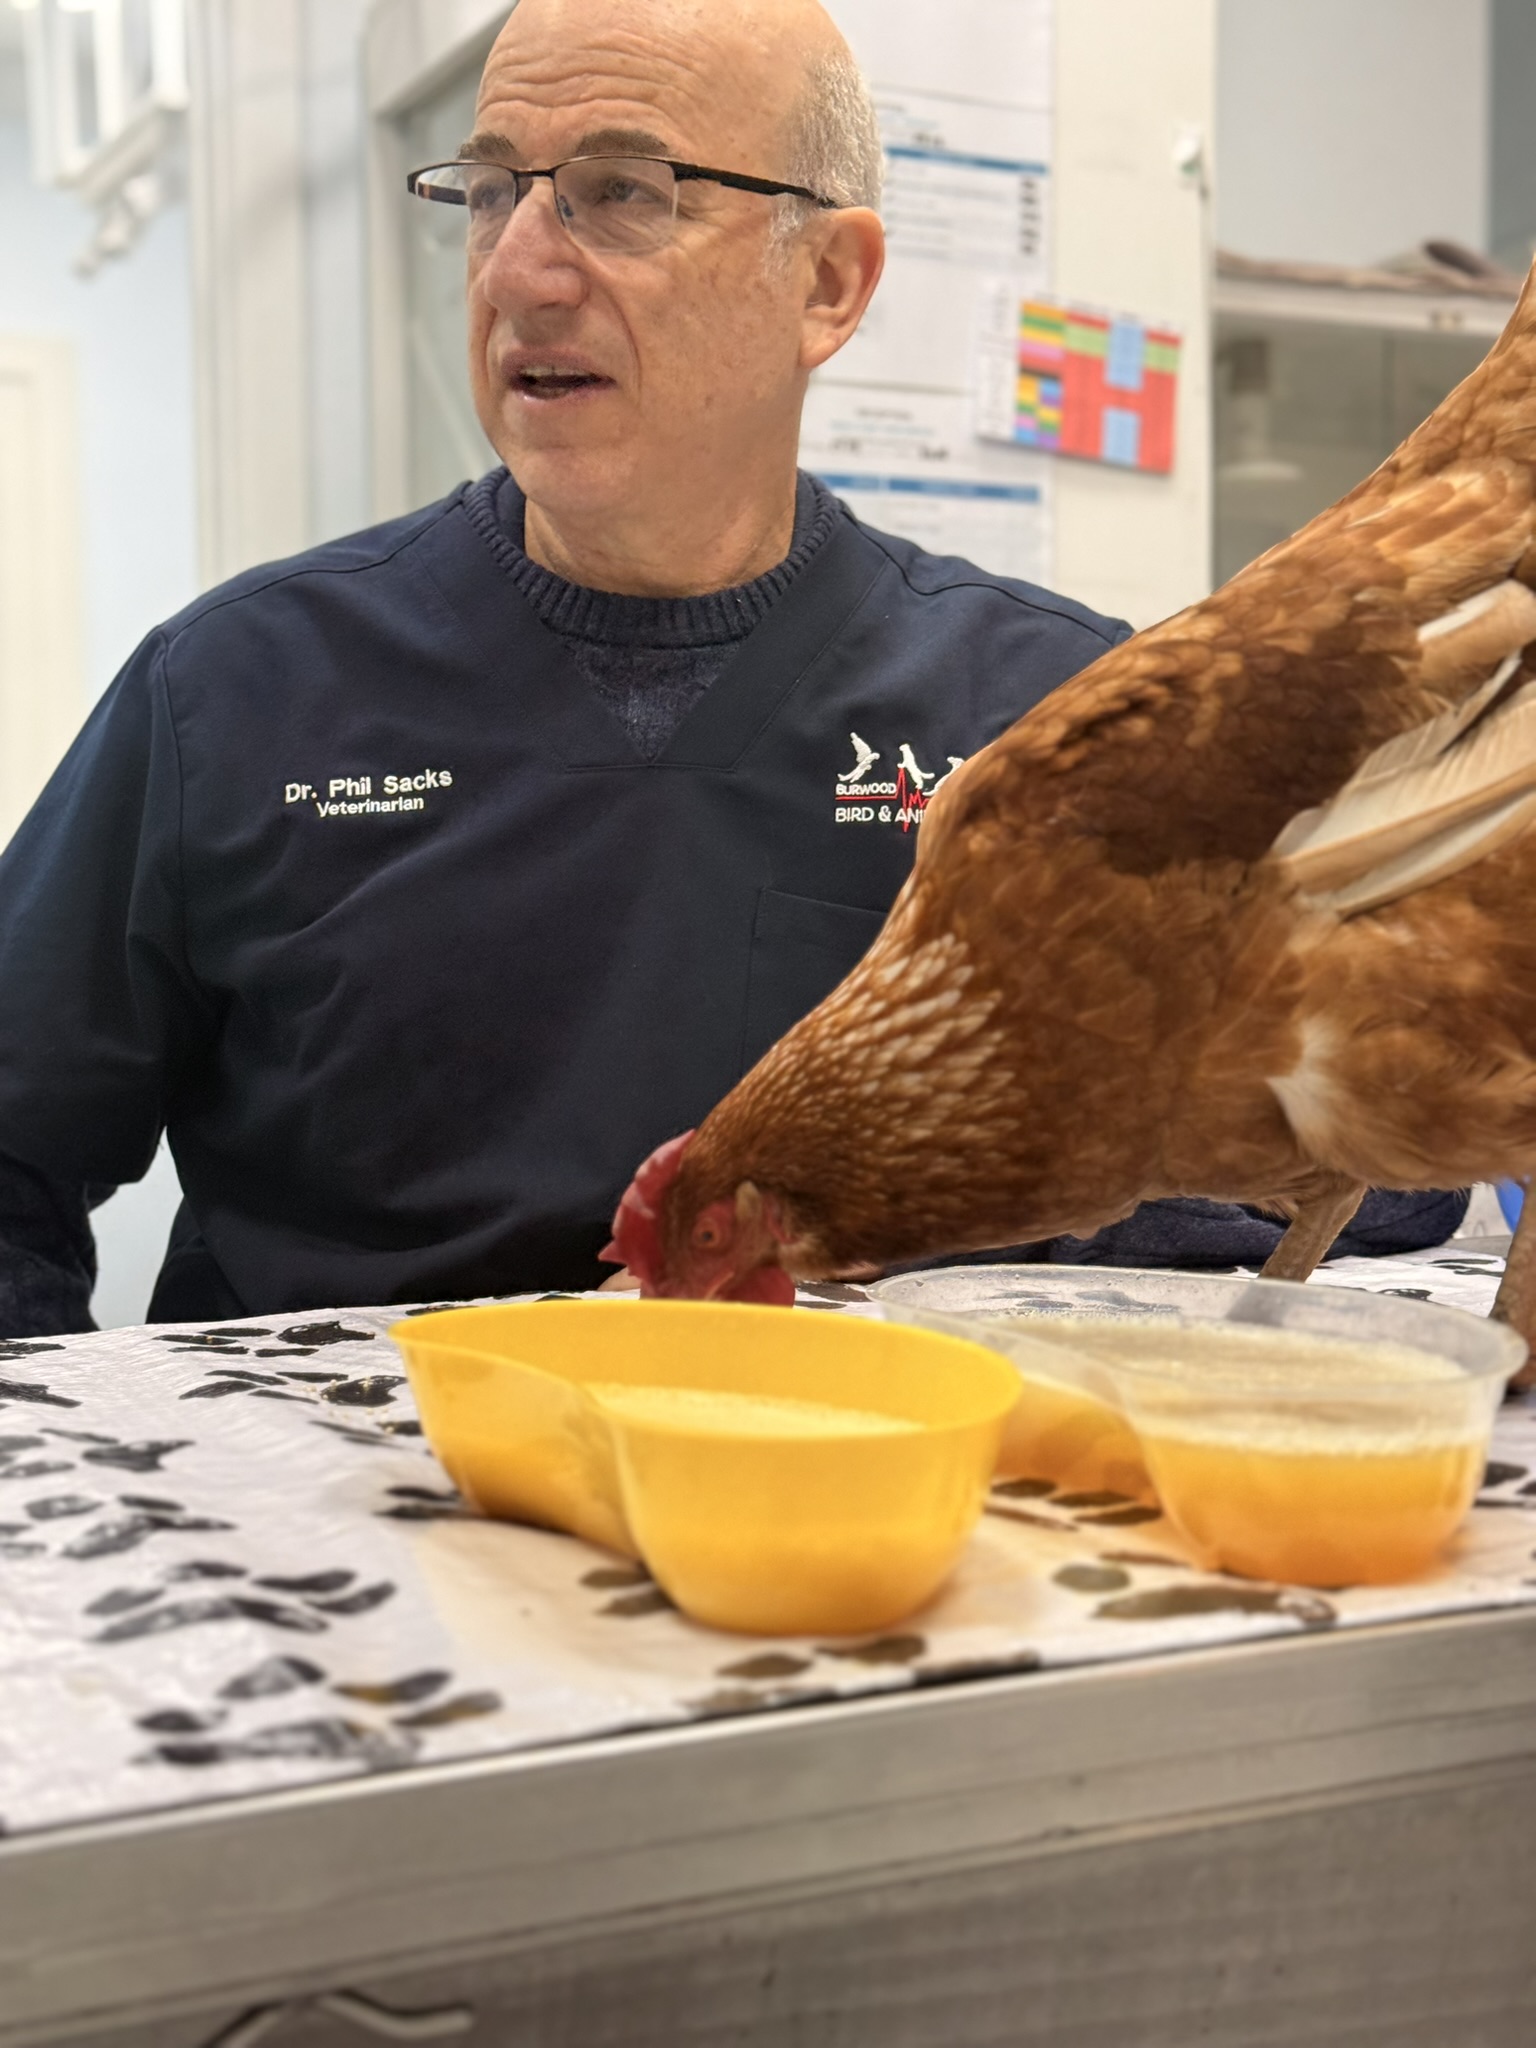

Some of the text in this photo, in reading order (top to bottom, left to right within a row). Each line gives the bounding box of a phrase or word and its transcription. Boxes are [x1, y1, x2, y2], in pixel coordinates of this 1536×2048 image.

[285, 769, 453, 803] Dr. Phil Sacks
[835, 782, 897, 796] BURWOOD
[316, 796, 425, 818] Veterinarian
[835, 805, 927, 824] BIRD & ANI
